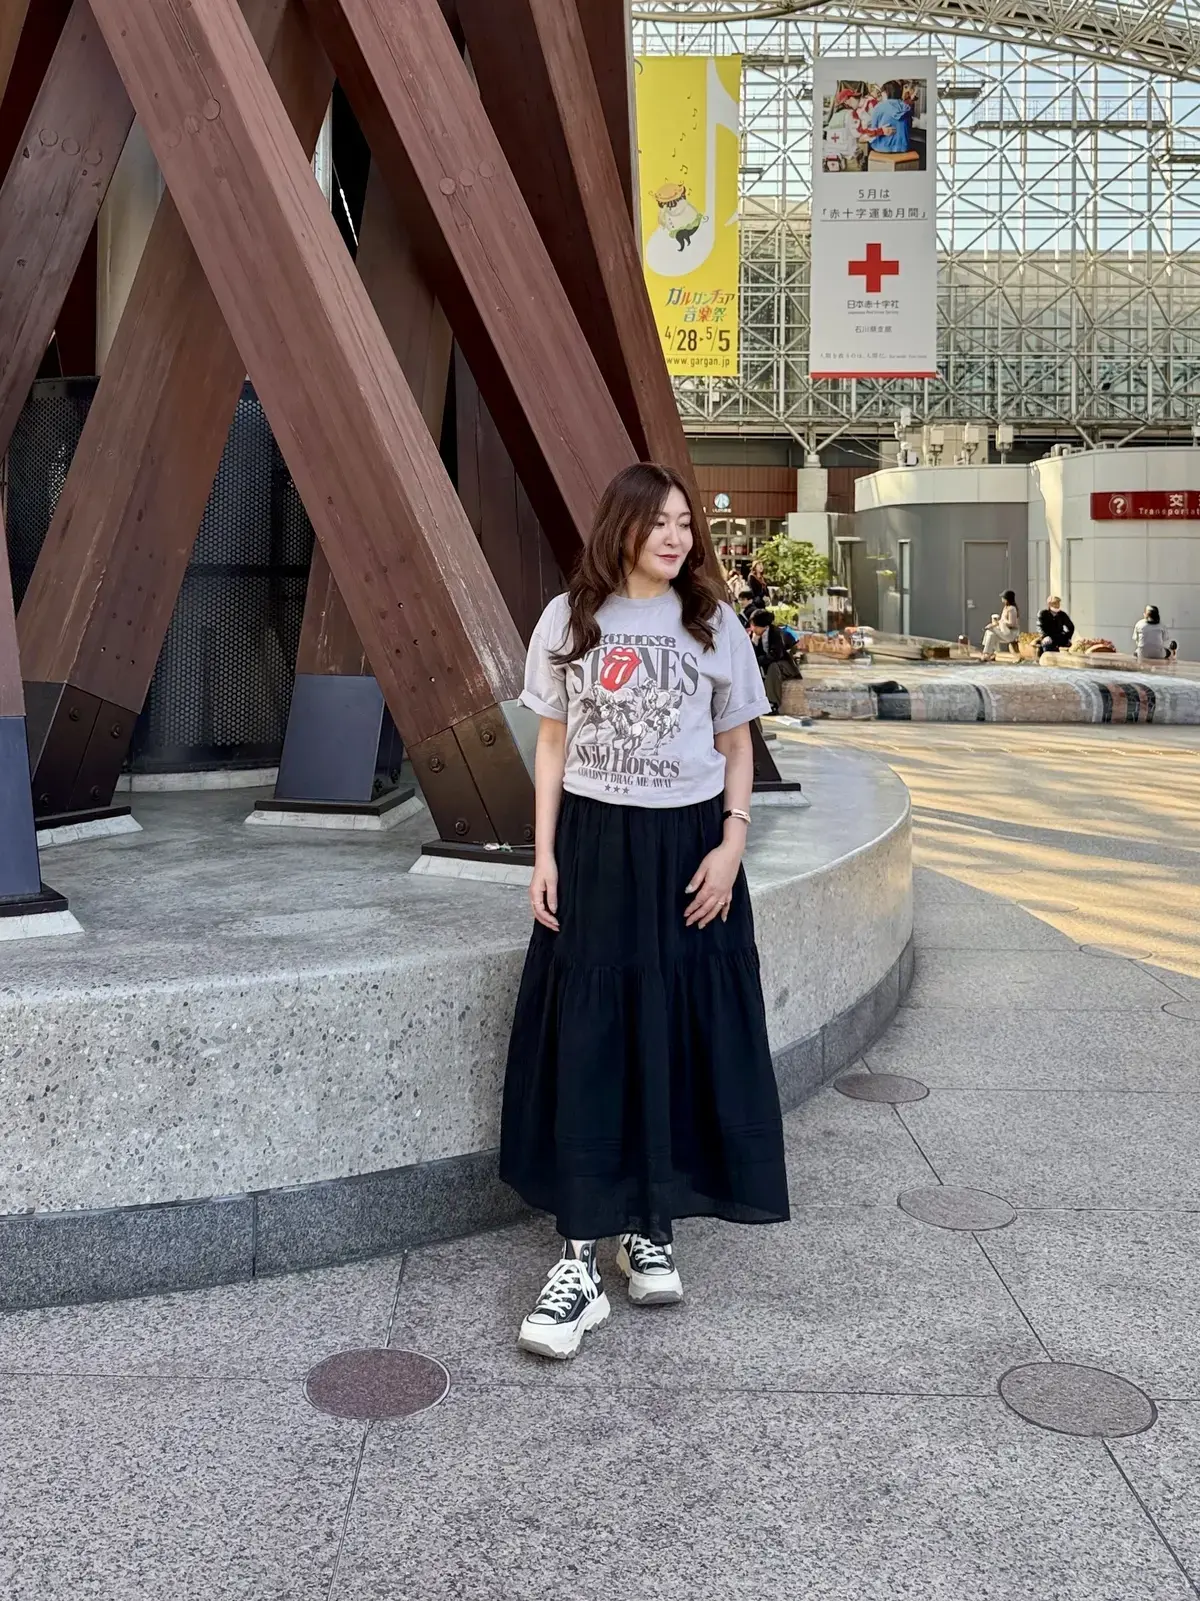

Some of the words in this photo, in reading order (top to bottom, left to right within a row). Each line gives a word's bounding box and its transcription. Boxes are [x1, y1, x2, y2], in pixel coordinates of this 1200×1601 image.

[858, 188, 890, 199] 5月は
[822, 207, 926, 219] 「赤十字運動月間」
[600, 633, 676, 648] OLLING
[575, 743, 611, 771] Wild
[611, 747, 680, 779] Horses
[610, 772, 634, 786] DRAG
[635, 776, 649, 787] ME
